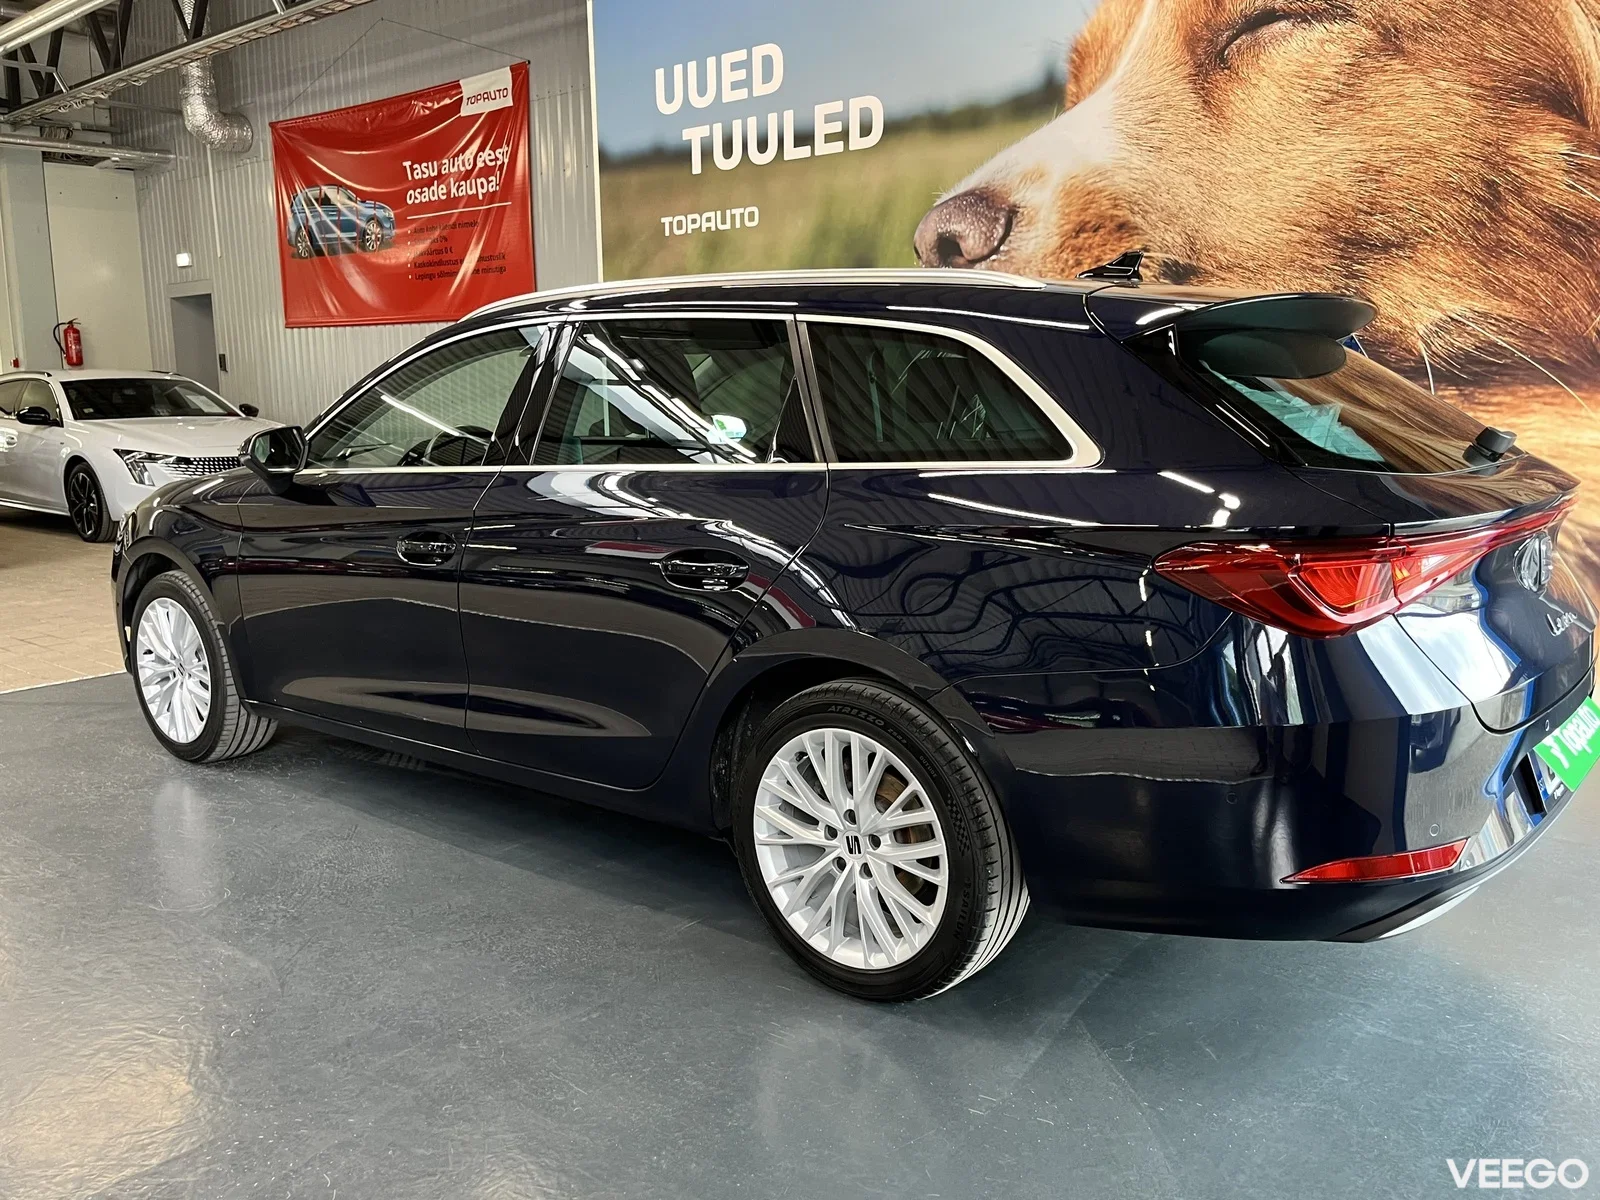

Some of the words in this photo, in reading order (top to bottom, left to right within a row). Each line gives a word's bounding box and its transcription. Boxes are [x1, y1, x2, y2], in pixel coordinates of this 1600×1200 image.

[655, 43, 784, 115] UUED
[466, 88, 509, 106] TOPAUTO
[682, 95, 884, 175] TUULED
[403, 161, 438, 180] Tasu
[441, 153, 474, 174] auto
[476, 145, 509, 168] eest
[406, 180, 447, 205] osade
[450, 171, 500, 200] kaupa!
[661, 206, 760, 237] TOPAUTO
[827, 705, 885, 726] ATREZZO
